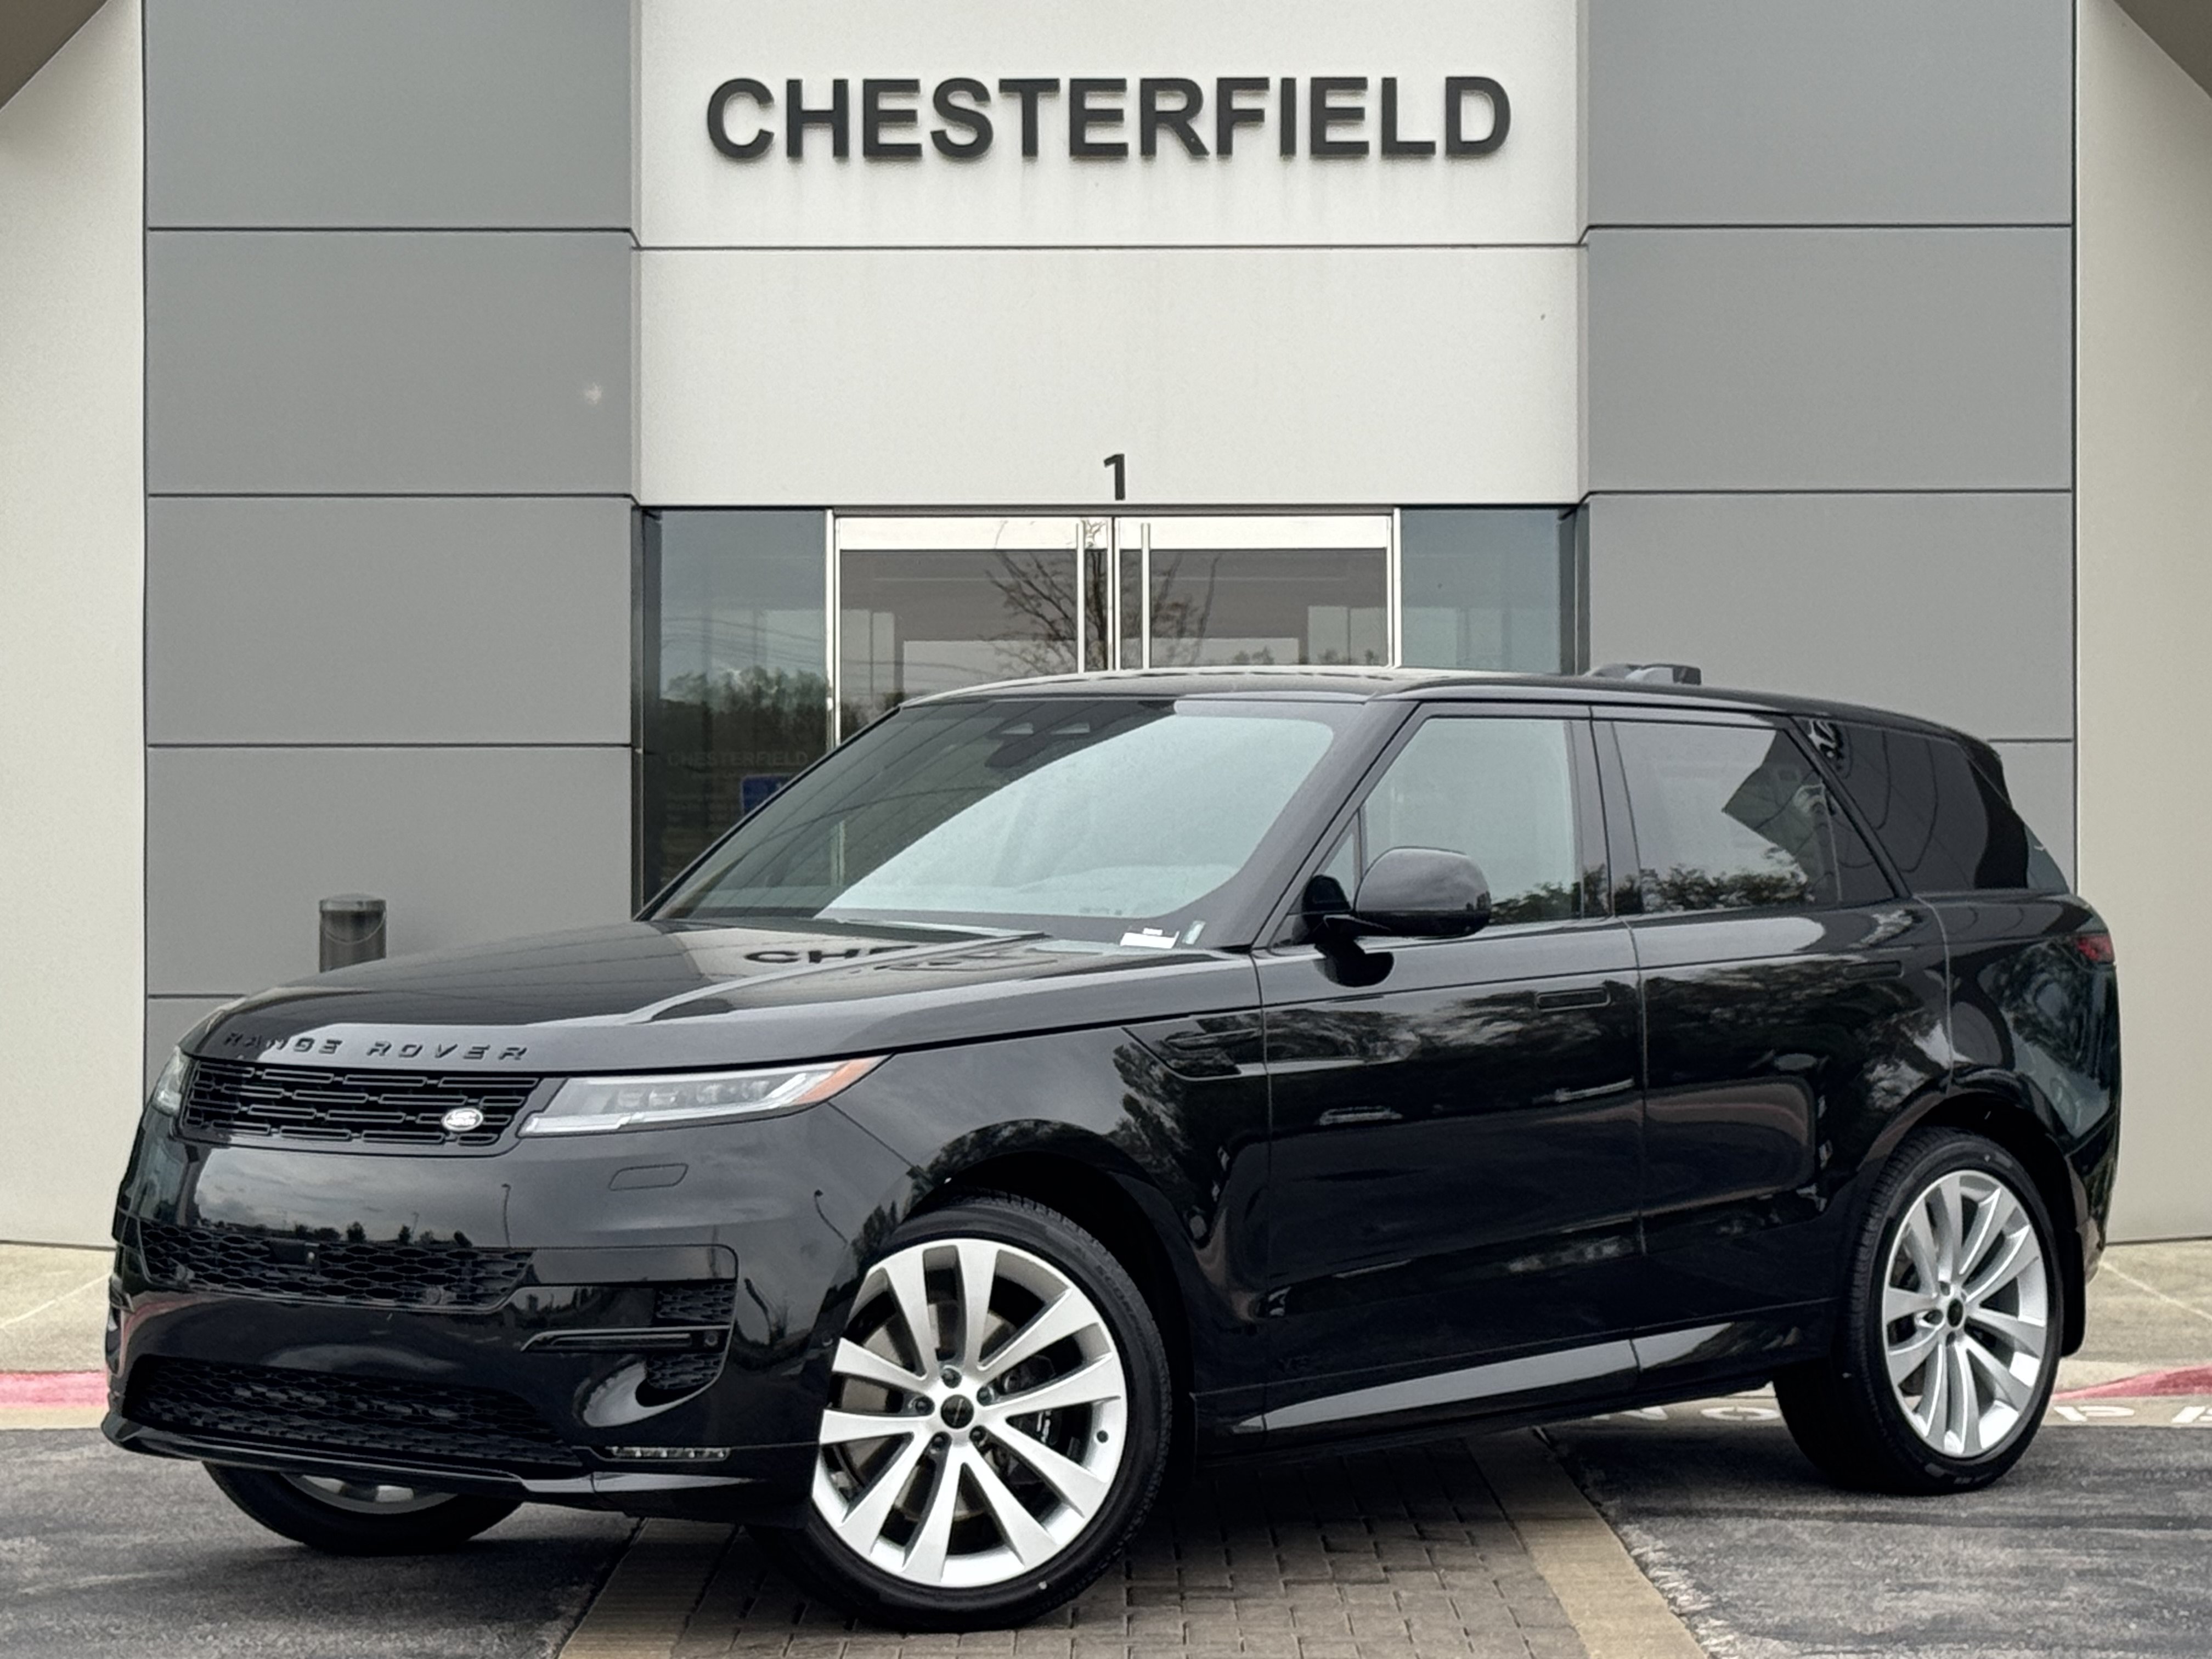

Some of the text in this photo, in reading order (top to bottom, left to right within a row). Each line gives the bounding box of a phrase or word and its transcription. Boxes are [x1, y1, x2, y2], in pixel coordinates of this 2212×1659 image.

[707, 76, 1511, 161] CHESTERFIELD
[1103, 453, 1126, 501] 1
[668, 751, 808, 766] CHESTERFIELD
[224, 1032, 528, 1060] RANGE ROVER
